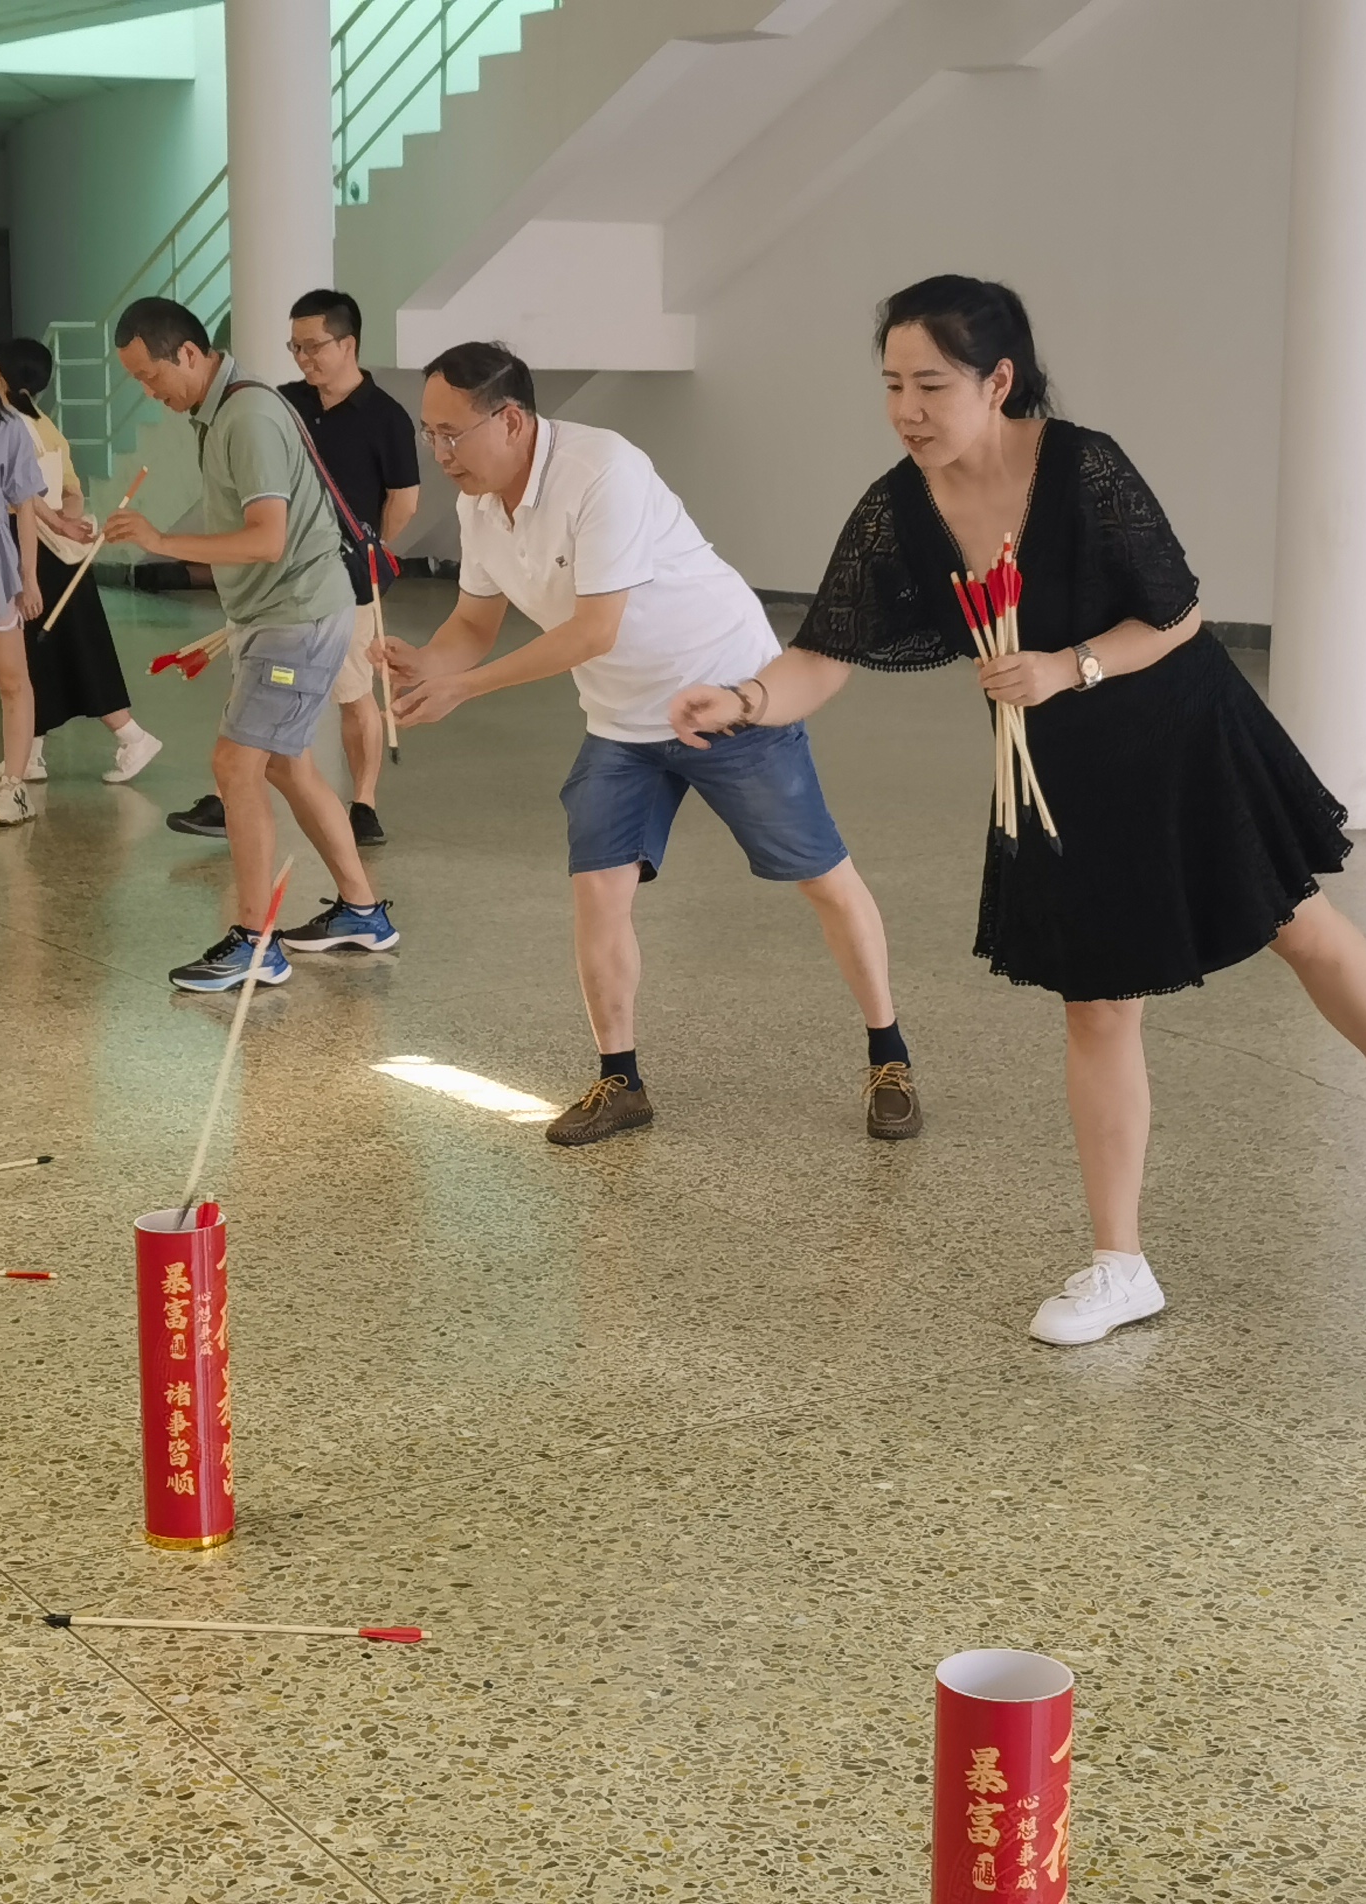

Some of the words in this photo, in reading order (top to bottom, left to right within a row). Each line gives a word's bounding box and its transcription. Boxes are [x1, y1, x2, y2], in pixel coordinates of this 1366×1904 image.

[164, 1380, 195, 1495] 诸事皆顺
[964, 1746, 1008, 1848] 暴富
[1015, 1795, 1040, 1890] 心想事成
